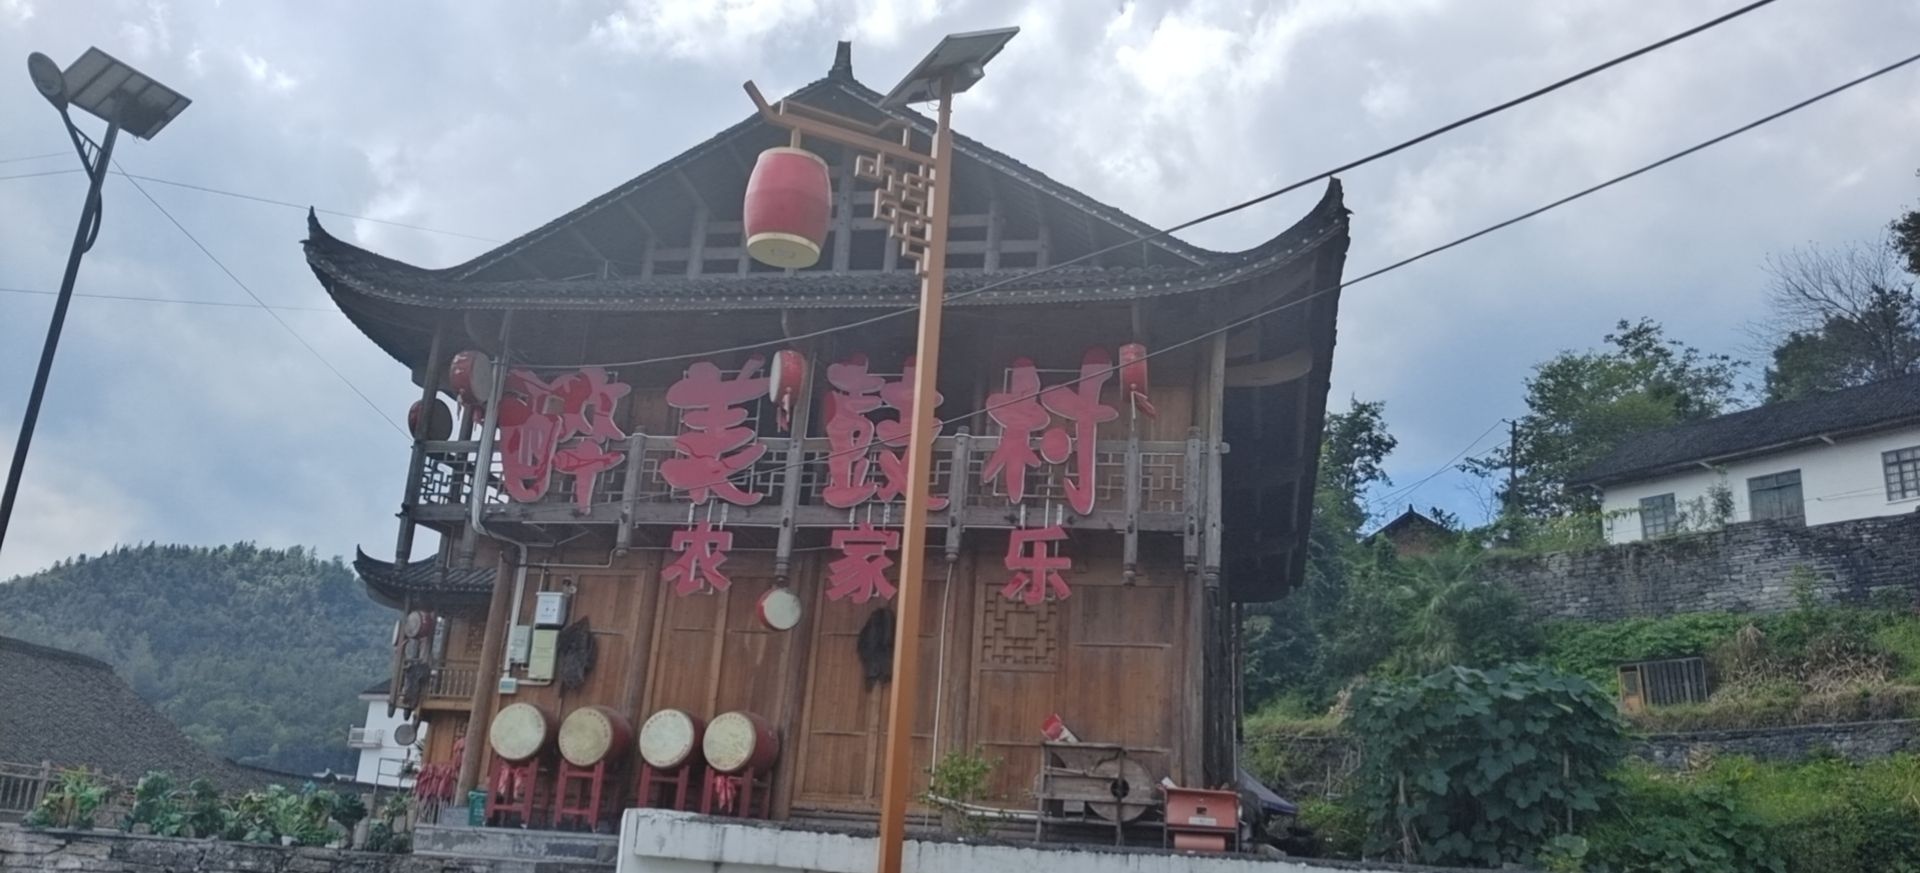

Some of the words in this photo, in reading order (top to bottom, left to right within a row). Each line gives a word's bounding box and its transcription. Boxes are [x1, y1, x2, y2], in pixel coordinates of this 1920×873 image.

[501, 347, 1119, 515] 醉美鼓村
[660, 519, 1072, 605] 农家乐
